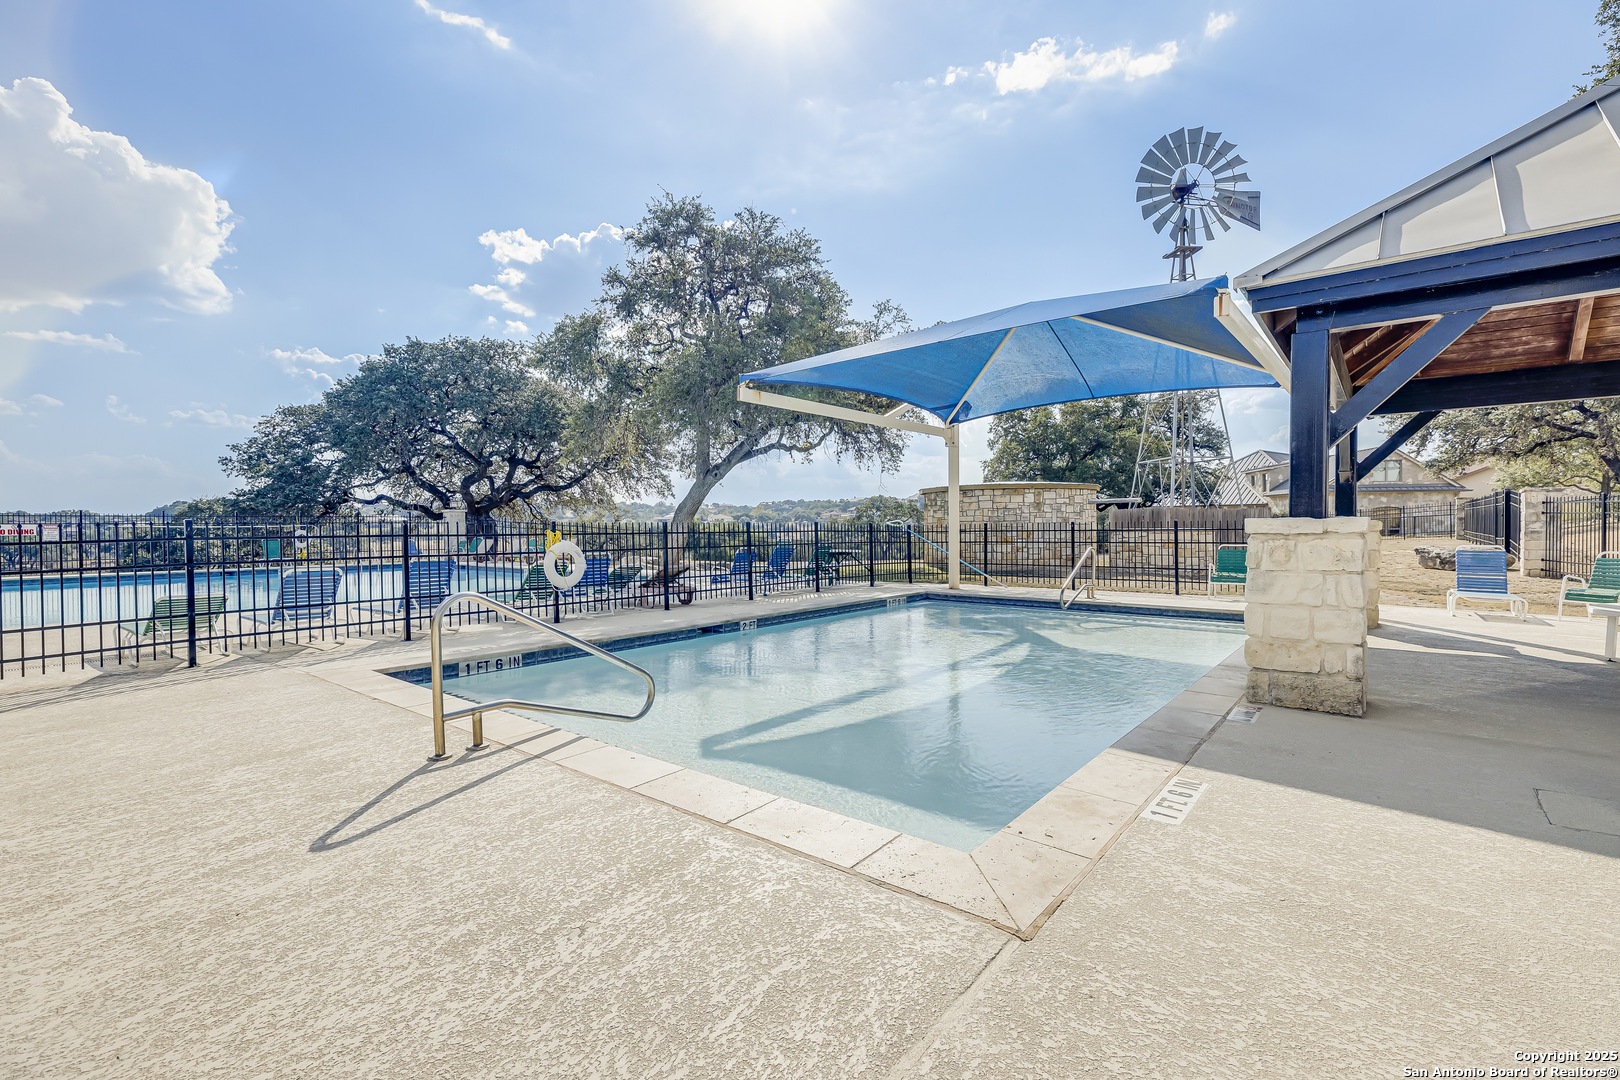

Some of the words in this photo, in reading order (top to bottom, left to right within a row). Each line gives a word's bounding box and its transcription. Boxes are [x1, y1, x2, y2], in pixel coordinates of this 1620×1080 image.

[742, 622, 747, 630] 2
[749, 620, 756, 630] FT
[465, 662, 470, 675] 1
[476, 660, 490, 673] FT
[495, 658, 503, 670] 6
[508, 655, 520, 668] IN
[1172, 779, 1203, 791] IN
[1167, 789, 1193, 798] 6
[1155, 797, 1188, 812] FT
[1150, 810, 1178, 819] 1
